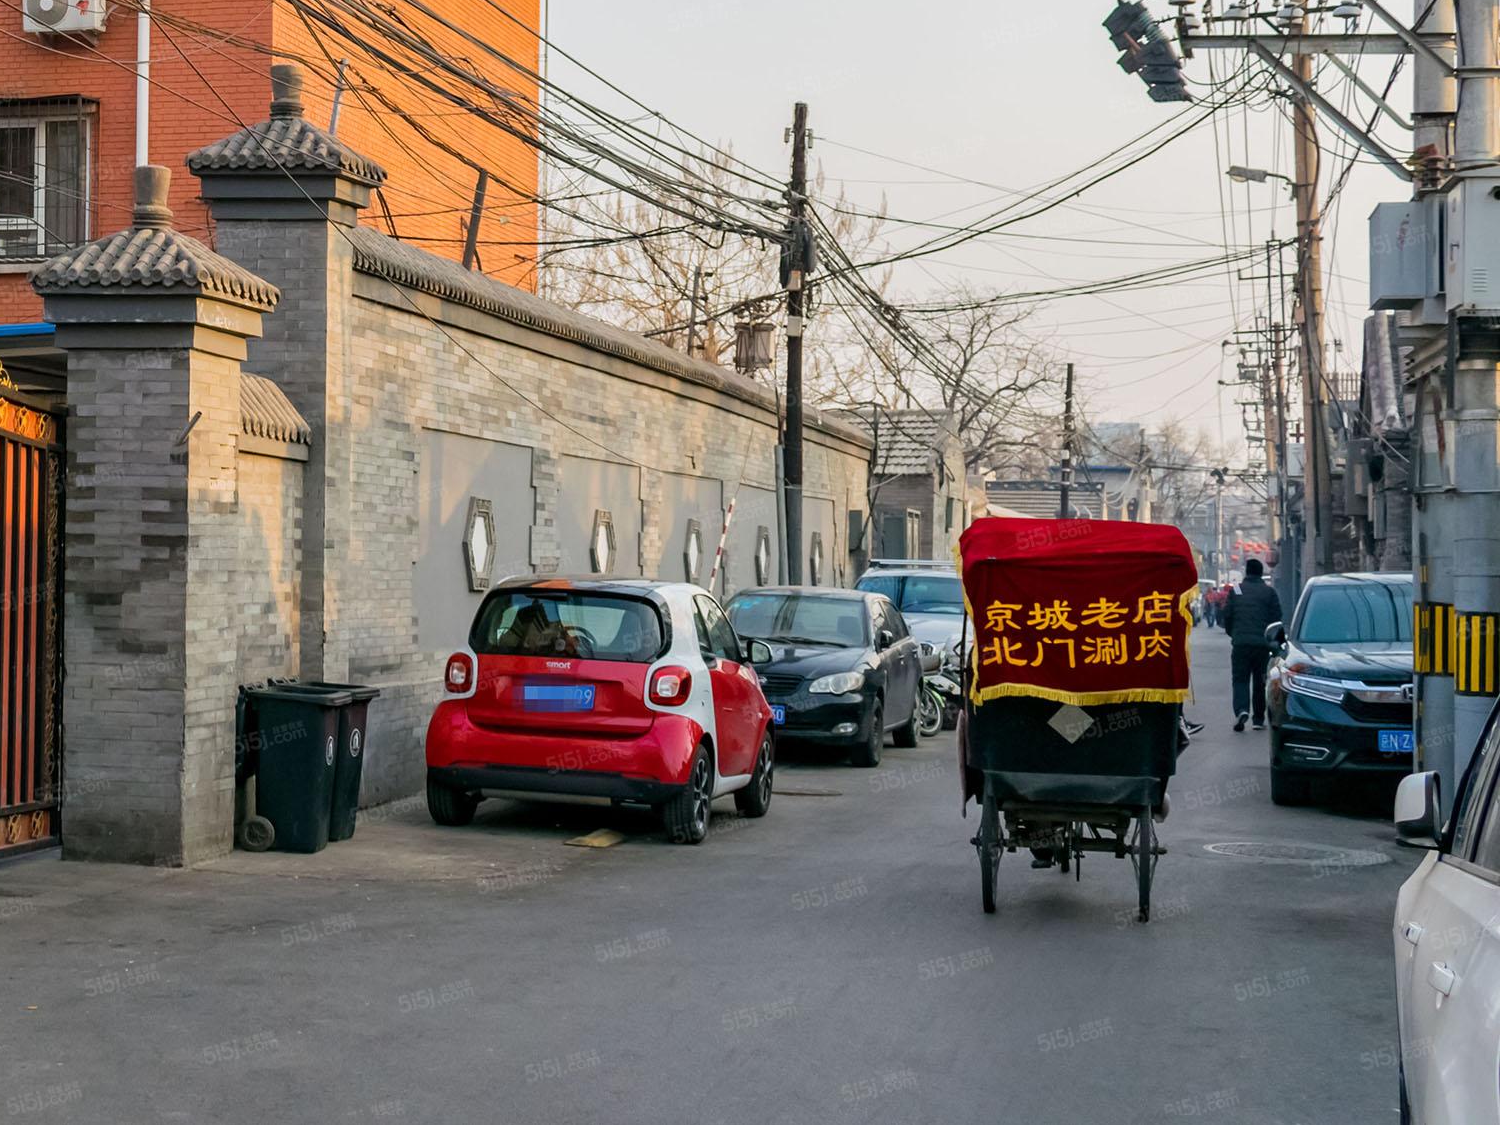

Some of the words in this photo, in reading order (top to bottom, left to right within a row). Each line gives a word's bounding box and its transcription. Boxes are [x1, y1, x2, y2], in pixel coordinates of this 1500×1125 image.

[984, 590, 1175, 632] 京城老店
[546, 661, 571, 669] smart
[982, 629, 1173, 669] 北门涮肉
